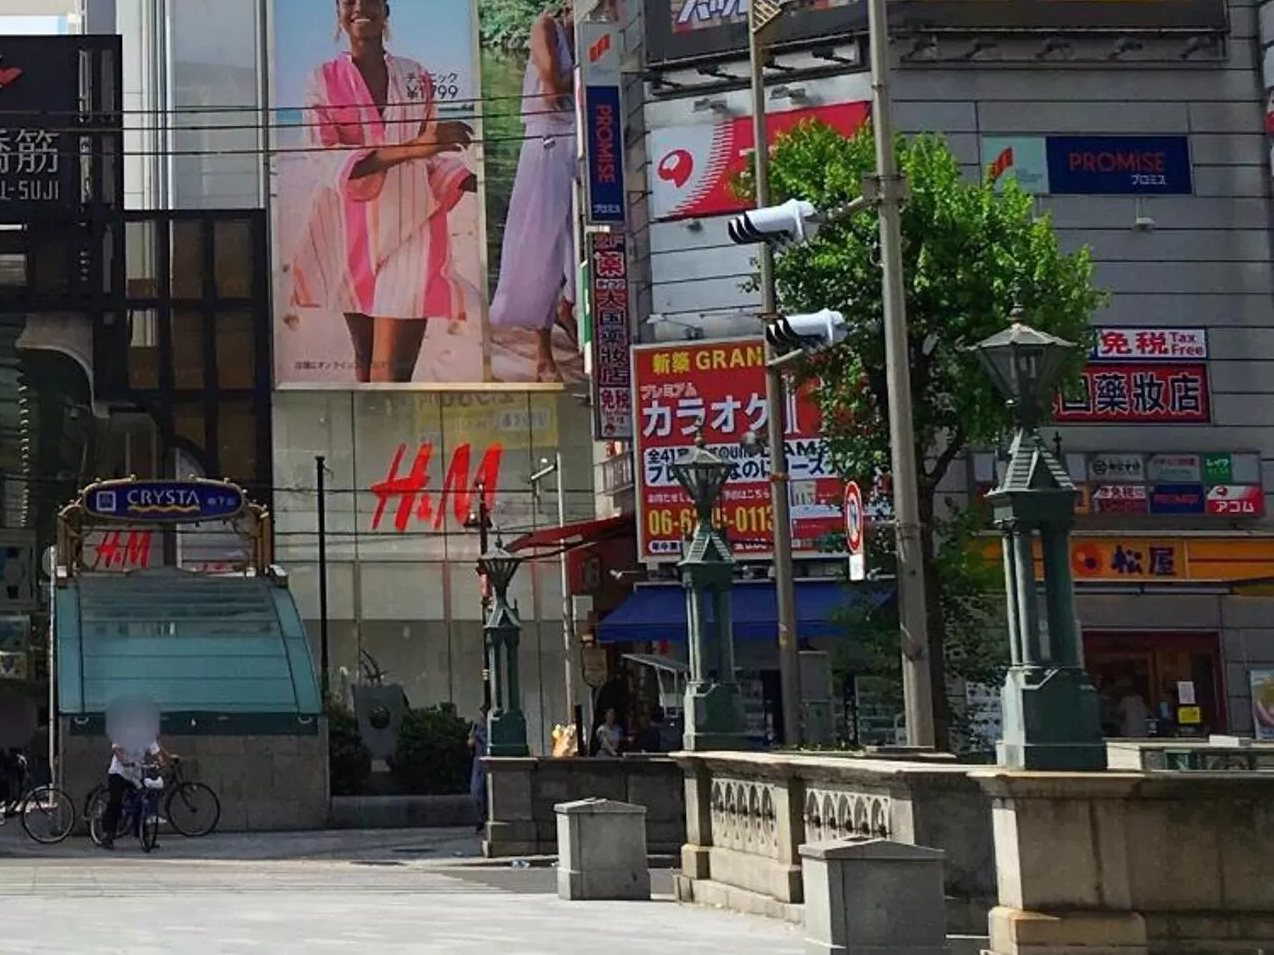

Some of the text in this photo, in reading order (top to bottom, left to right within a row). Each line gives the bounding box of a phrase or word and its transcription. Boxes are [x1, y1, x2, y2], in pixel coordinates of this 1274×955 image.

[596, 105, 615, 183] PROMISE
[1069, 153, 1166, 173] PROMISE
[1132, 174, 1166, 185] プロミス
[1101, 331, 1169, 355] 免税
[1169, 331, 1197, 344] Tax
[695, 346, 765, 371] GRAN
[1171, 345, 1205, 357] Free
[127, 489, 200, 505] CRYSTA
[370, 441, 503, 533] H&M
[95, 529, 151, 570] H&M
[1111, 545, 1176, 575] 松屋
